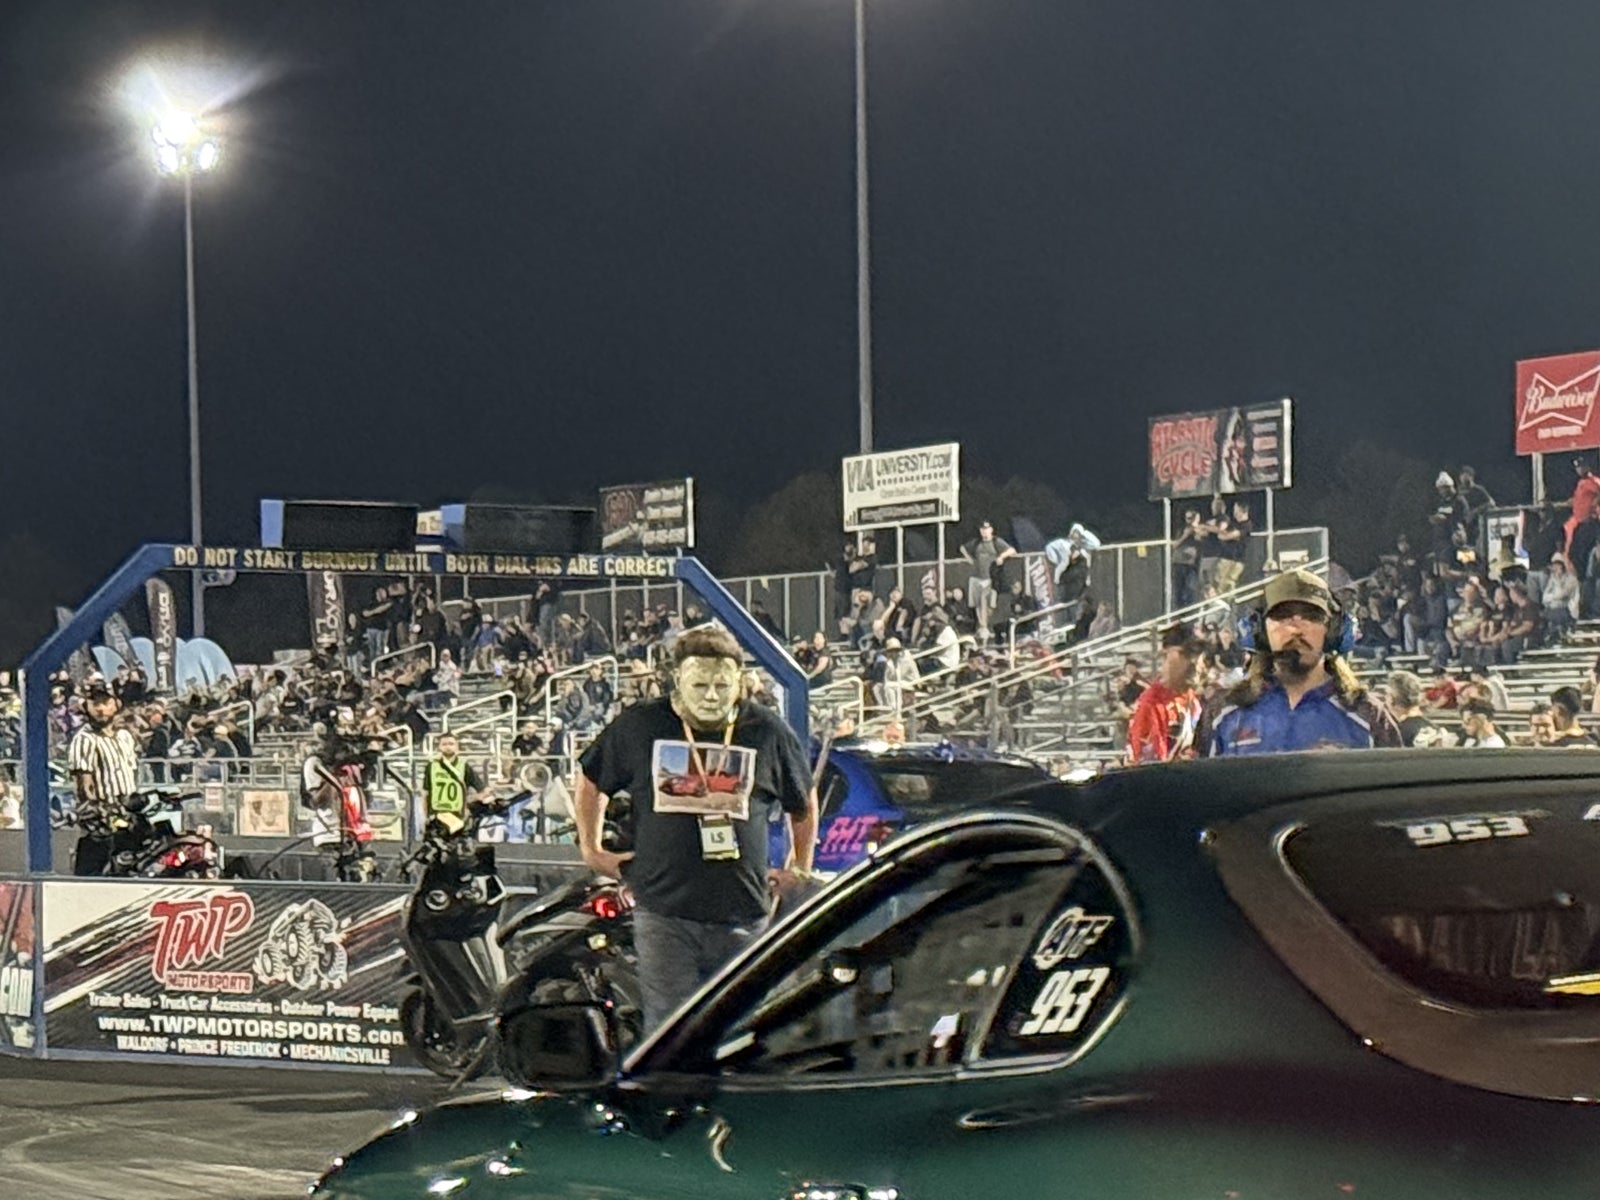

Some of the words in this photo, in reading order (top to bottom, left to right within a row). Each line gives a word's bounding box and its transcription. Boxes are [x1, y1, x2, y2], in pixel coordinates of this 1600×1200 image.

[1527, 387, 1596, 414] Budweiser
[174, 547, 198, 566] DO
[204, 548, 236, 567] NOT
[243, 549, 297, 569] START
[302, 551, 378, 571] BURNOUT
[385, 552, 432, 572] UNTIL
[446, 554, 488, 574] BOTH
[567, 555, 599, 576] ARE
[604, 556, 677, 577] CORRECT
[435, 781, 458, 803] 70
[1405, 816, 1531, 848] 953
[150, 892, 254, 984] TWP
[88, 992, 122, 1007] Trailer
[123, 992, 152, 1009] Sales
[327, 1001, 361, 1018] Power
[1019, 966, 1110, 1035] 953
[178, 1037, 219, 1056] PRINCE
[220, 1039, 281, 1059] FREDERICK
[290, 1043, 391, 1066] MECHANICSVILLE
